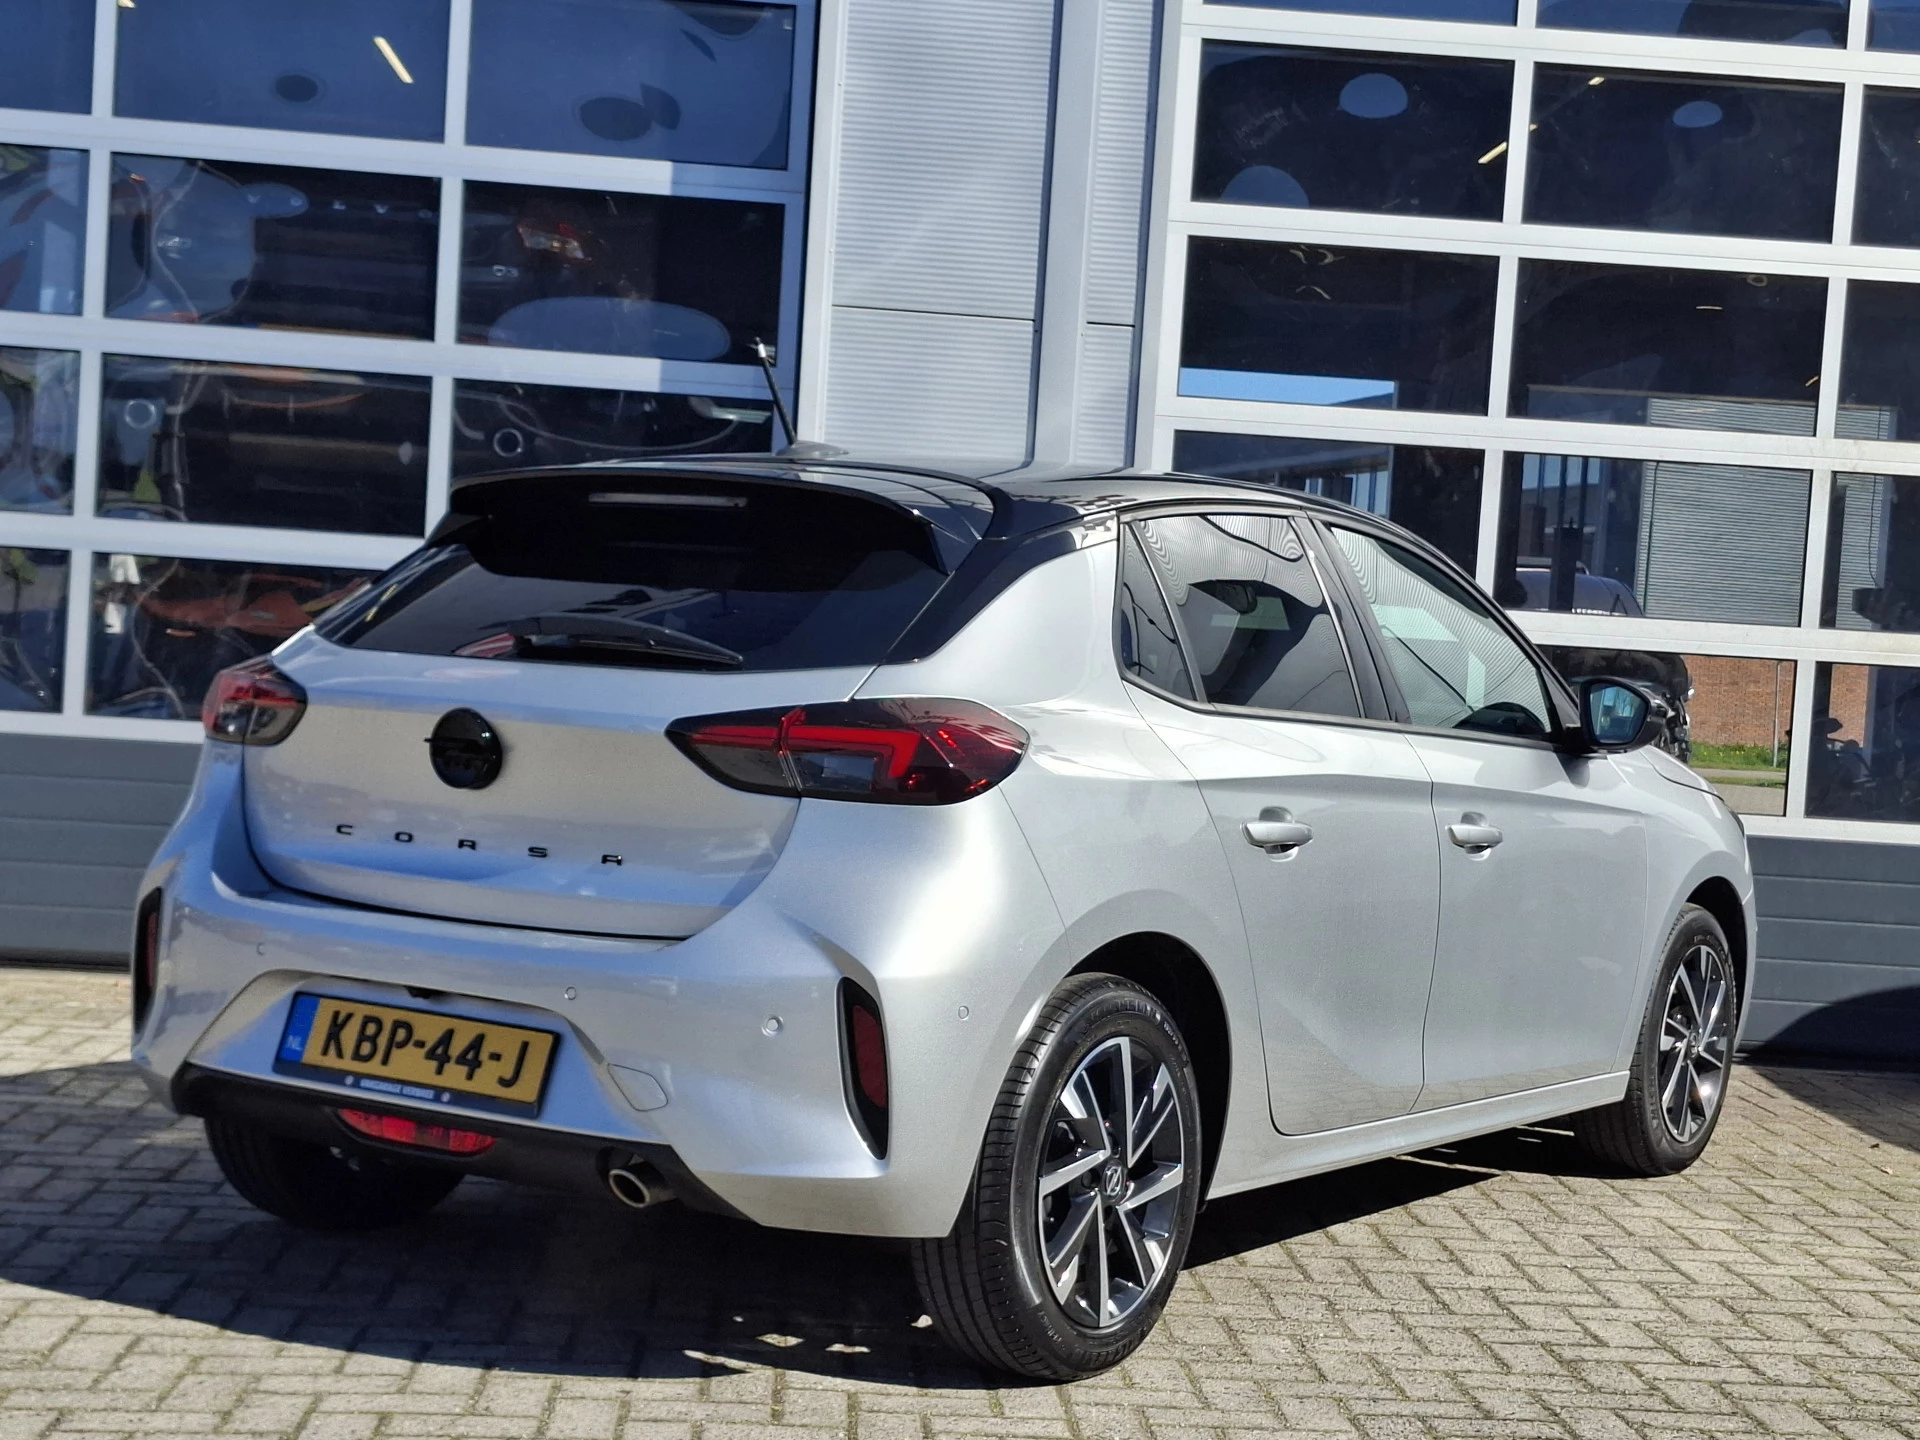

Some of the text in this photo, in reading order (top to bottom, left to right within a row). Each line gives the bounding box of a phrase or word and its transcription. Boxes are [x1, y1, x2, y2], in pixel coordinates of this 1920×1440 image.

[335, 824, 624, 867] CORSA
[286, 1035, 302, 1051] NL
[321, 1009, 530, 1088] KBP-44-J
